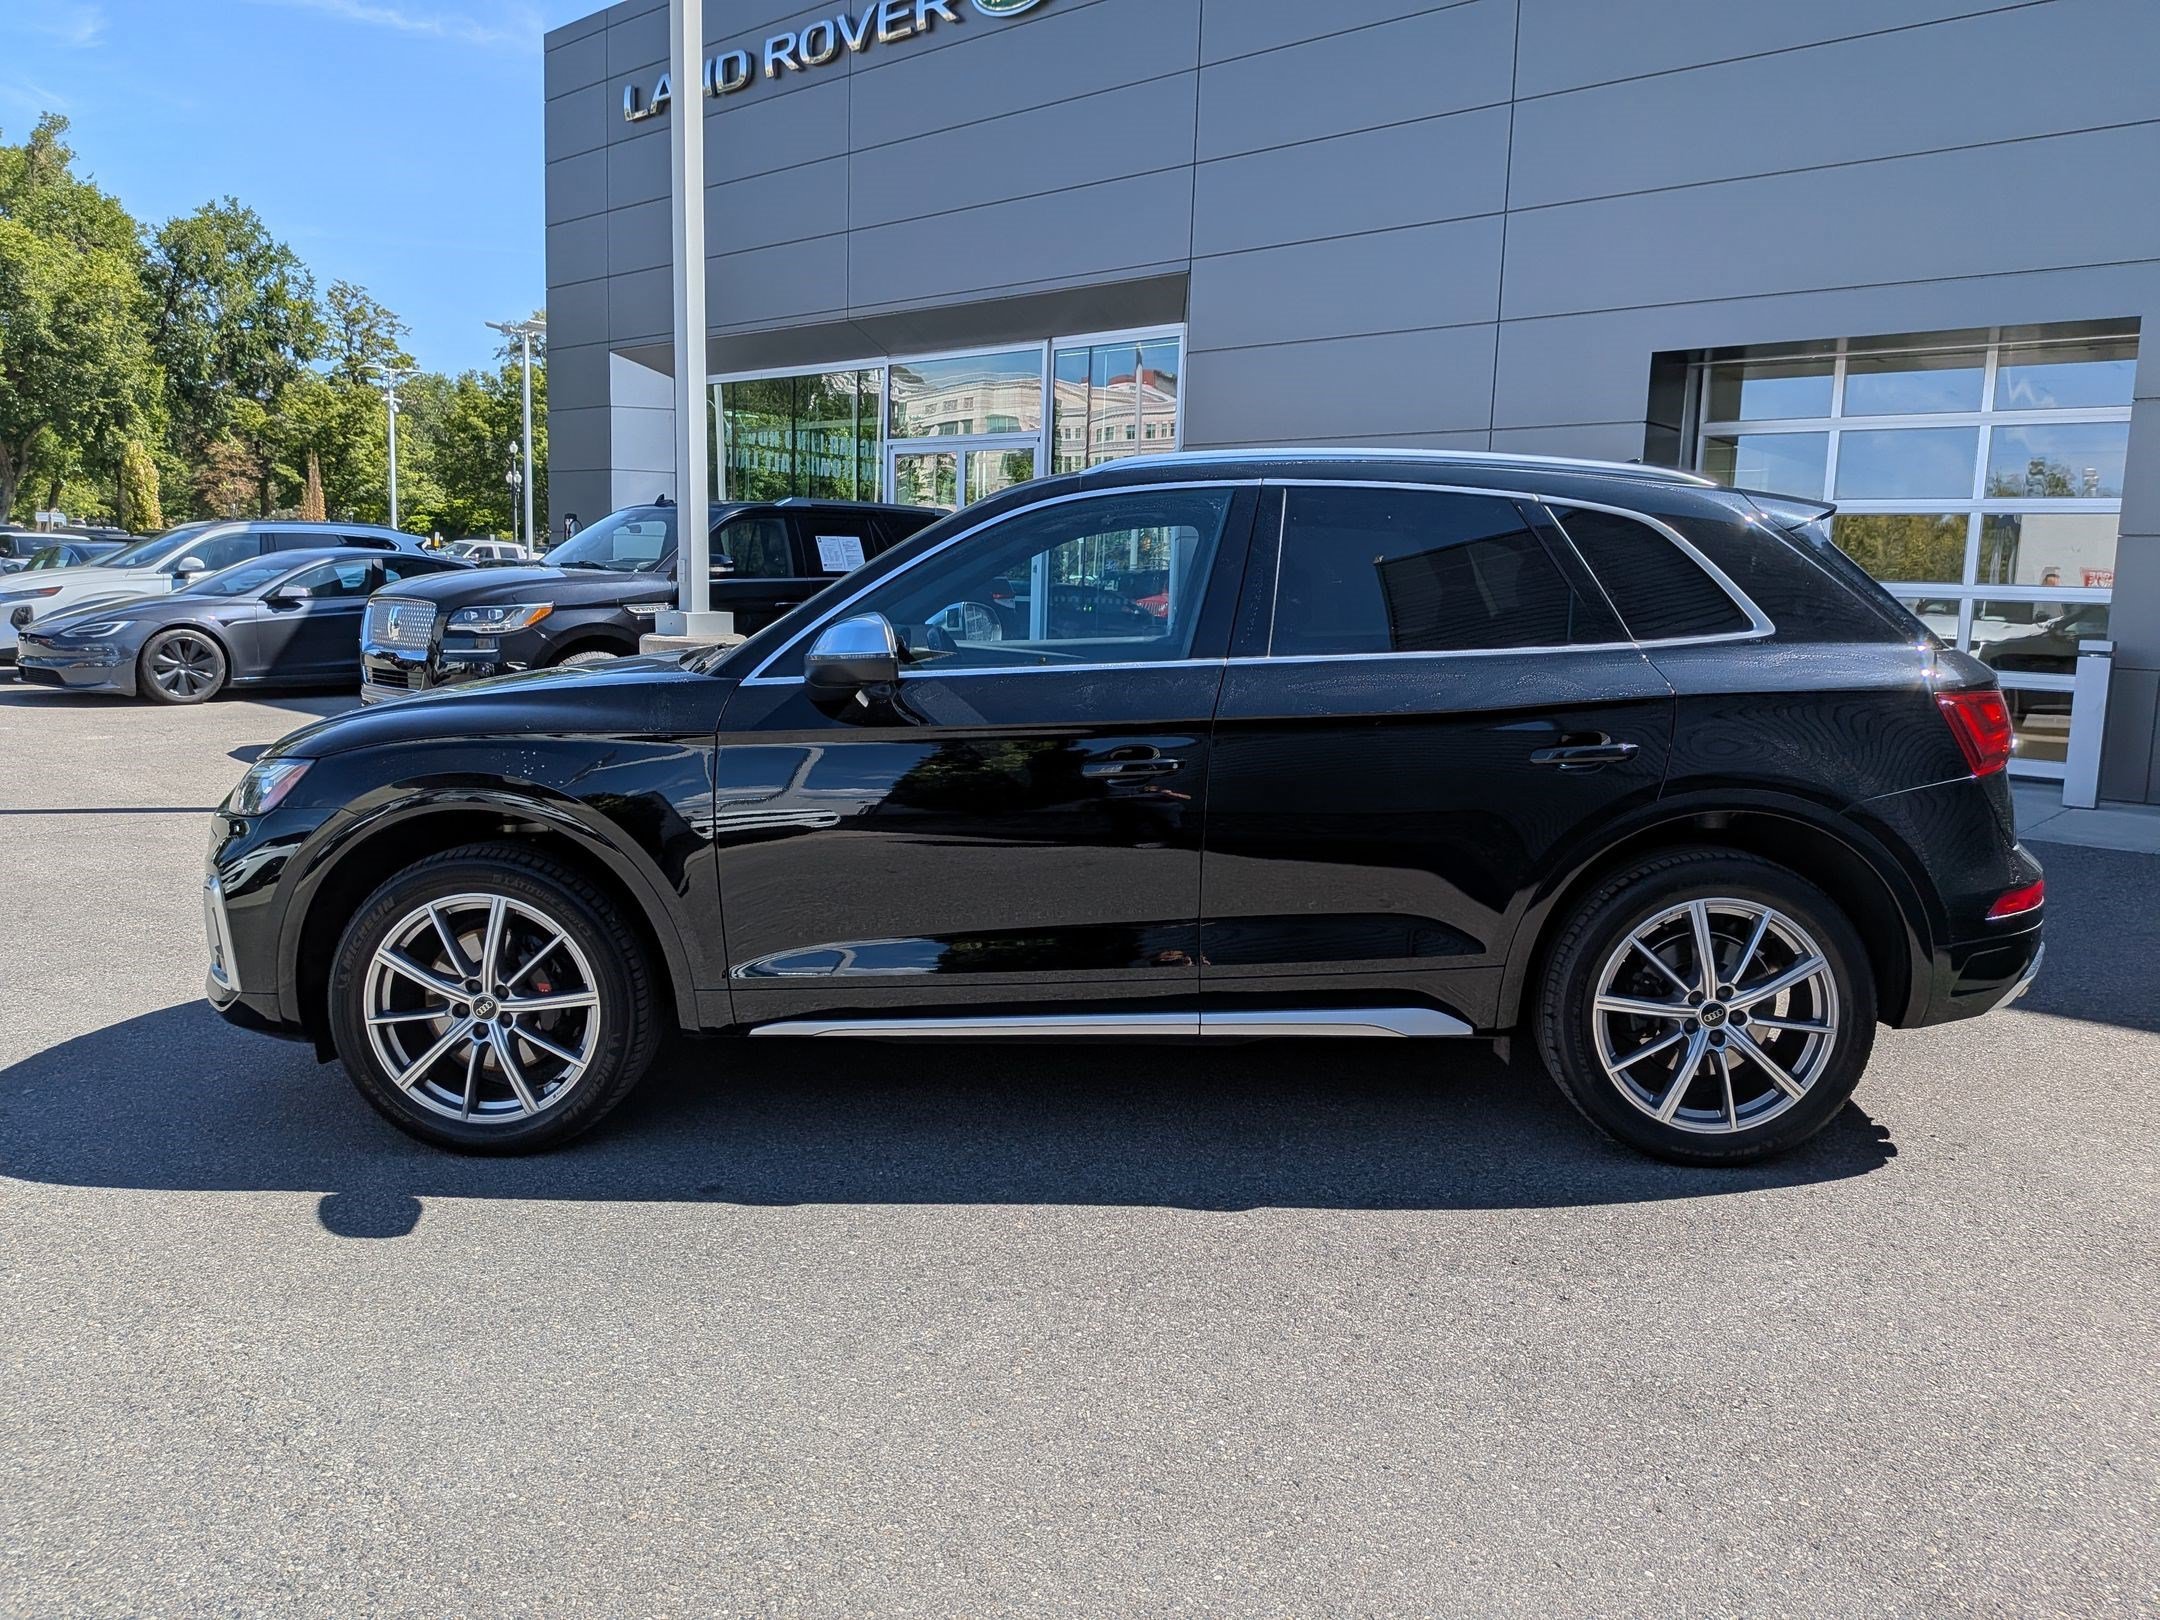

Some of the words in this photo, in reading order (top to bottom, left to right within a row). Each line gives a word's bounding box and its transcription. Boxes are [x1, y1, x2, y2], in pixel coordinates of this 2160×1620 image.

[764, 0, 957, 78] ROVER
[343, 895, 395, 970] MICHELIN
[562, 1055, 616, 1121] MICHELIN
